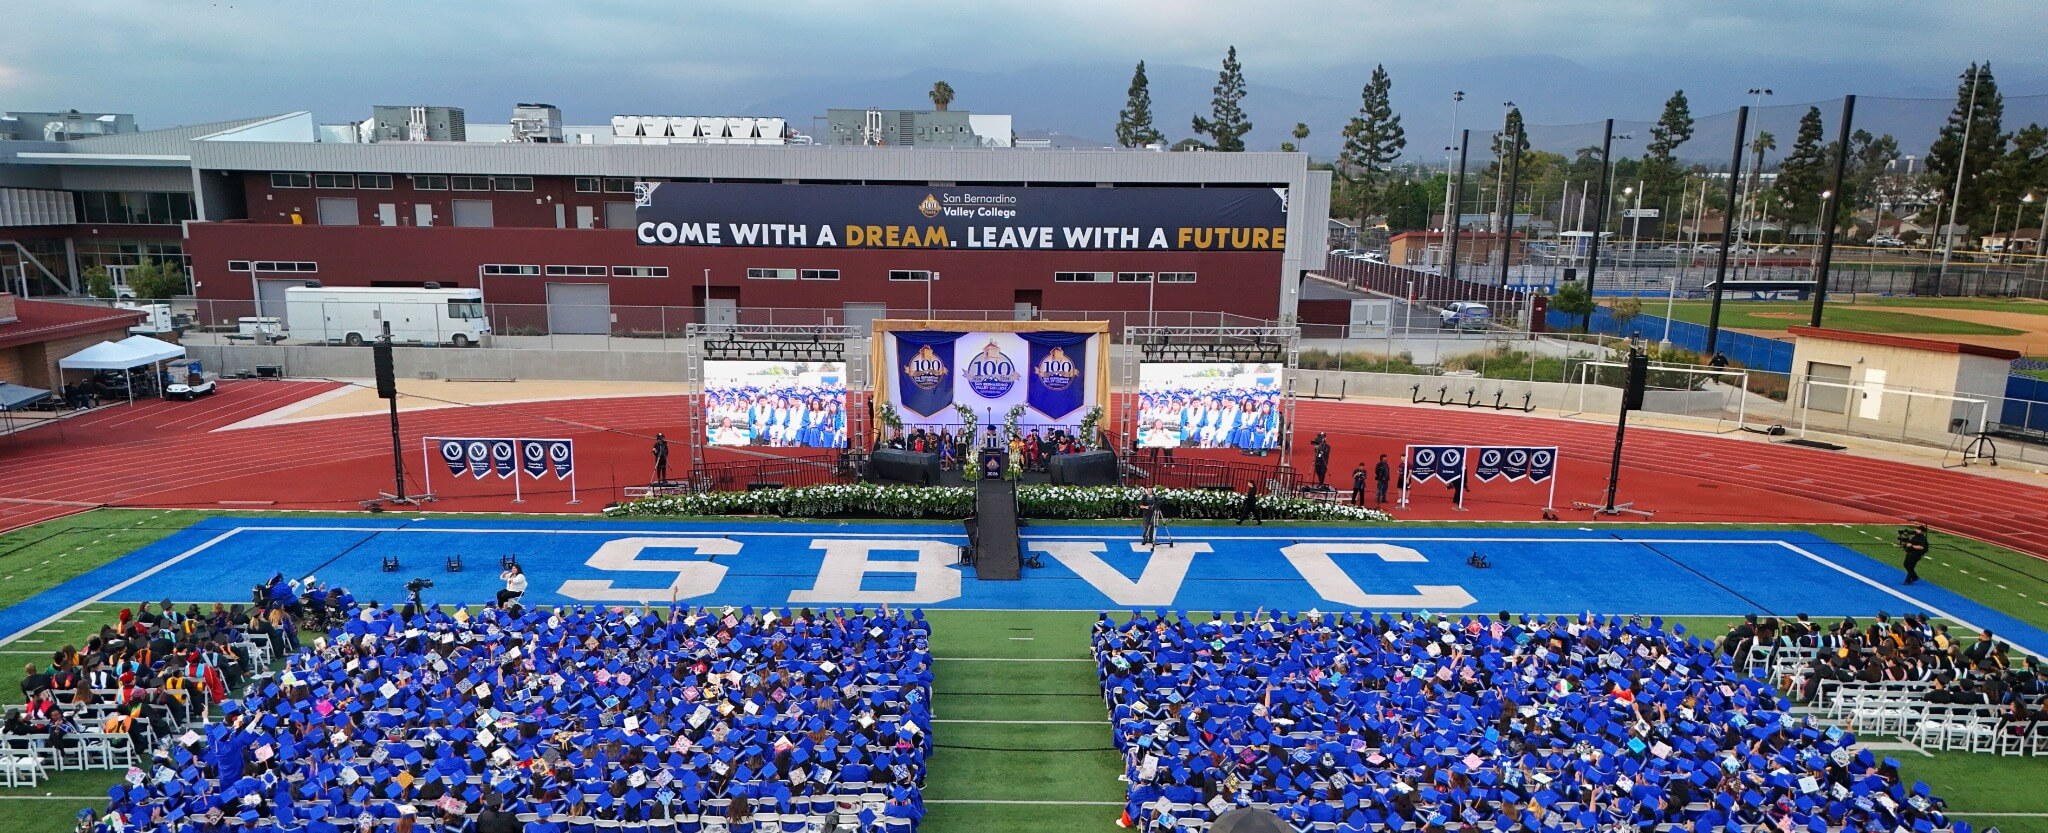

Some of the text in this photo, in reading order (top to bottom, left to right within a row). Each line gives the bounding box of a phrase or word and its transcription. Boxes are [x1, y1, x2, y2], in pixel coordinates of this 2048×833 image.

[943, 193, 1017, 204] San Bernardino
[943, 206, 1017, 219] Valley College
[637, 221, 1286, 249] COME WITH A DREAM. LEAVE WITH A FUTURE
[913, 359, 941, 371] 100
[974, 360, 1011, 376] 100
[1043, 360, 1072, 372] 100
